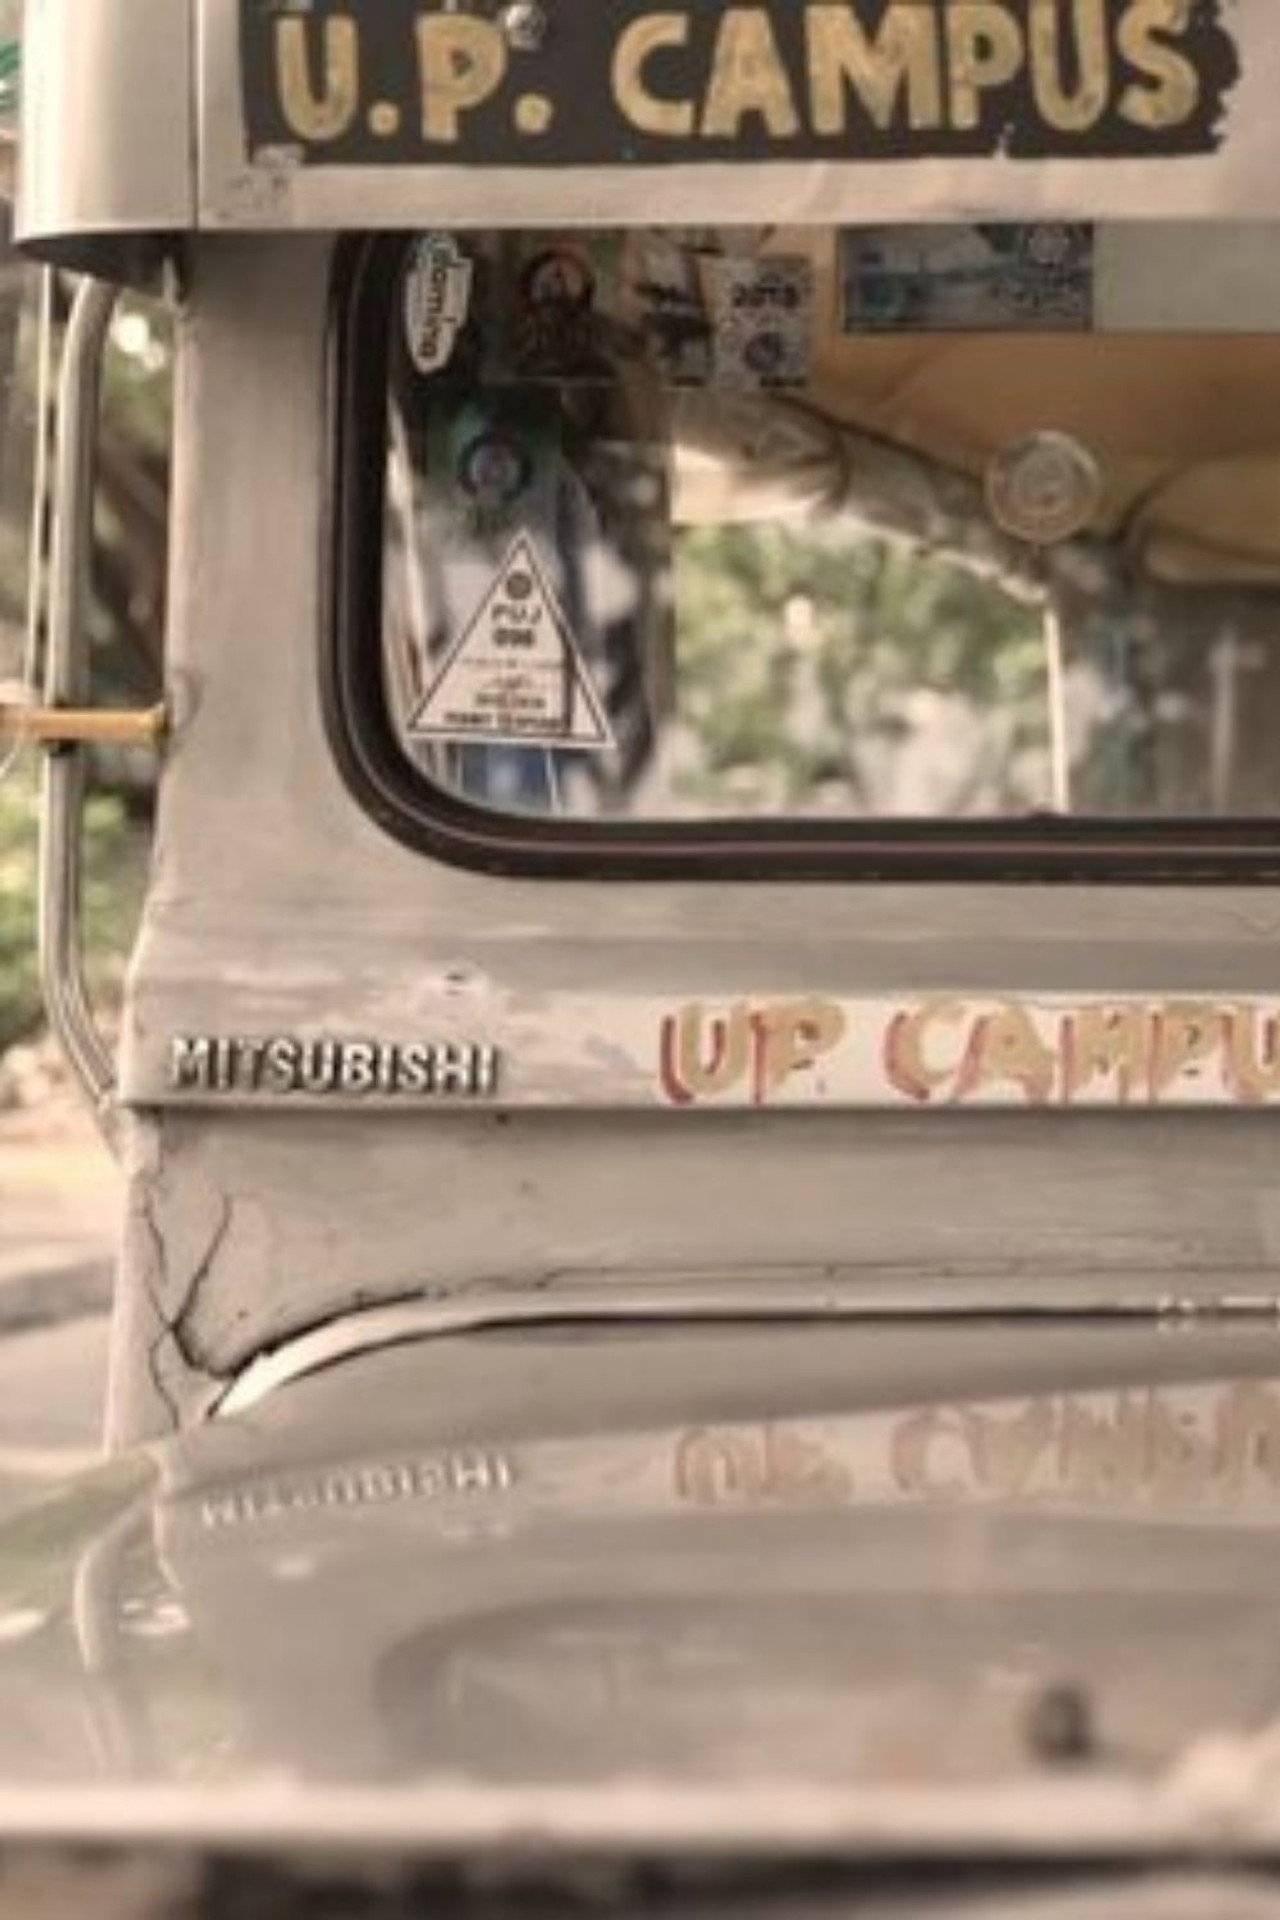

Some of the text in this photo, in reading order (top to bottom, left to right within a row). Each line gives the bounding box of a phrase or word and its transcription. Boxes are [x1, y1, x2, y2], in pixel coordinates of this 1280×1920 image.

[276, 0, 1197, 141] U.P. CAMPUS
[170, 1037, 497, 1093] MITSUBISHI
[659, 1001, 846, 1105] UP
